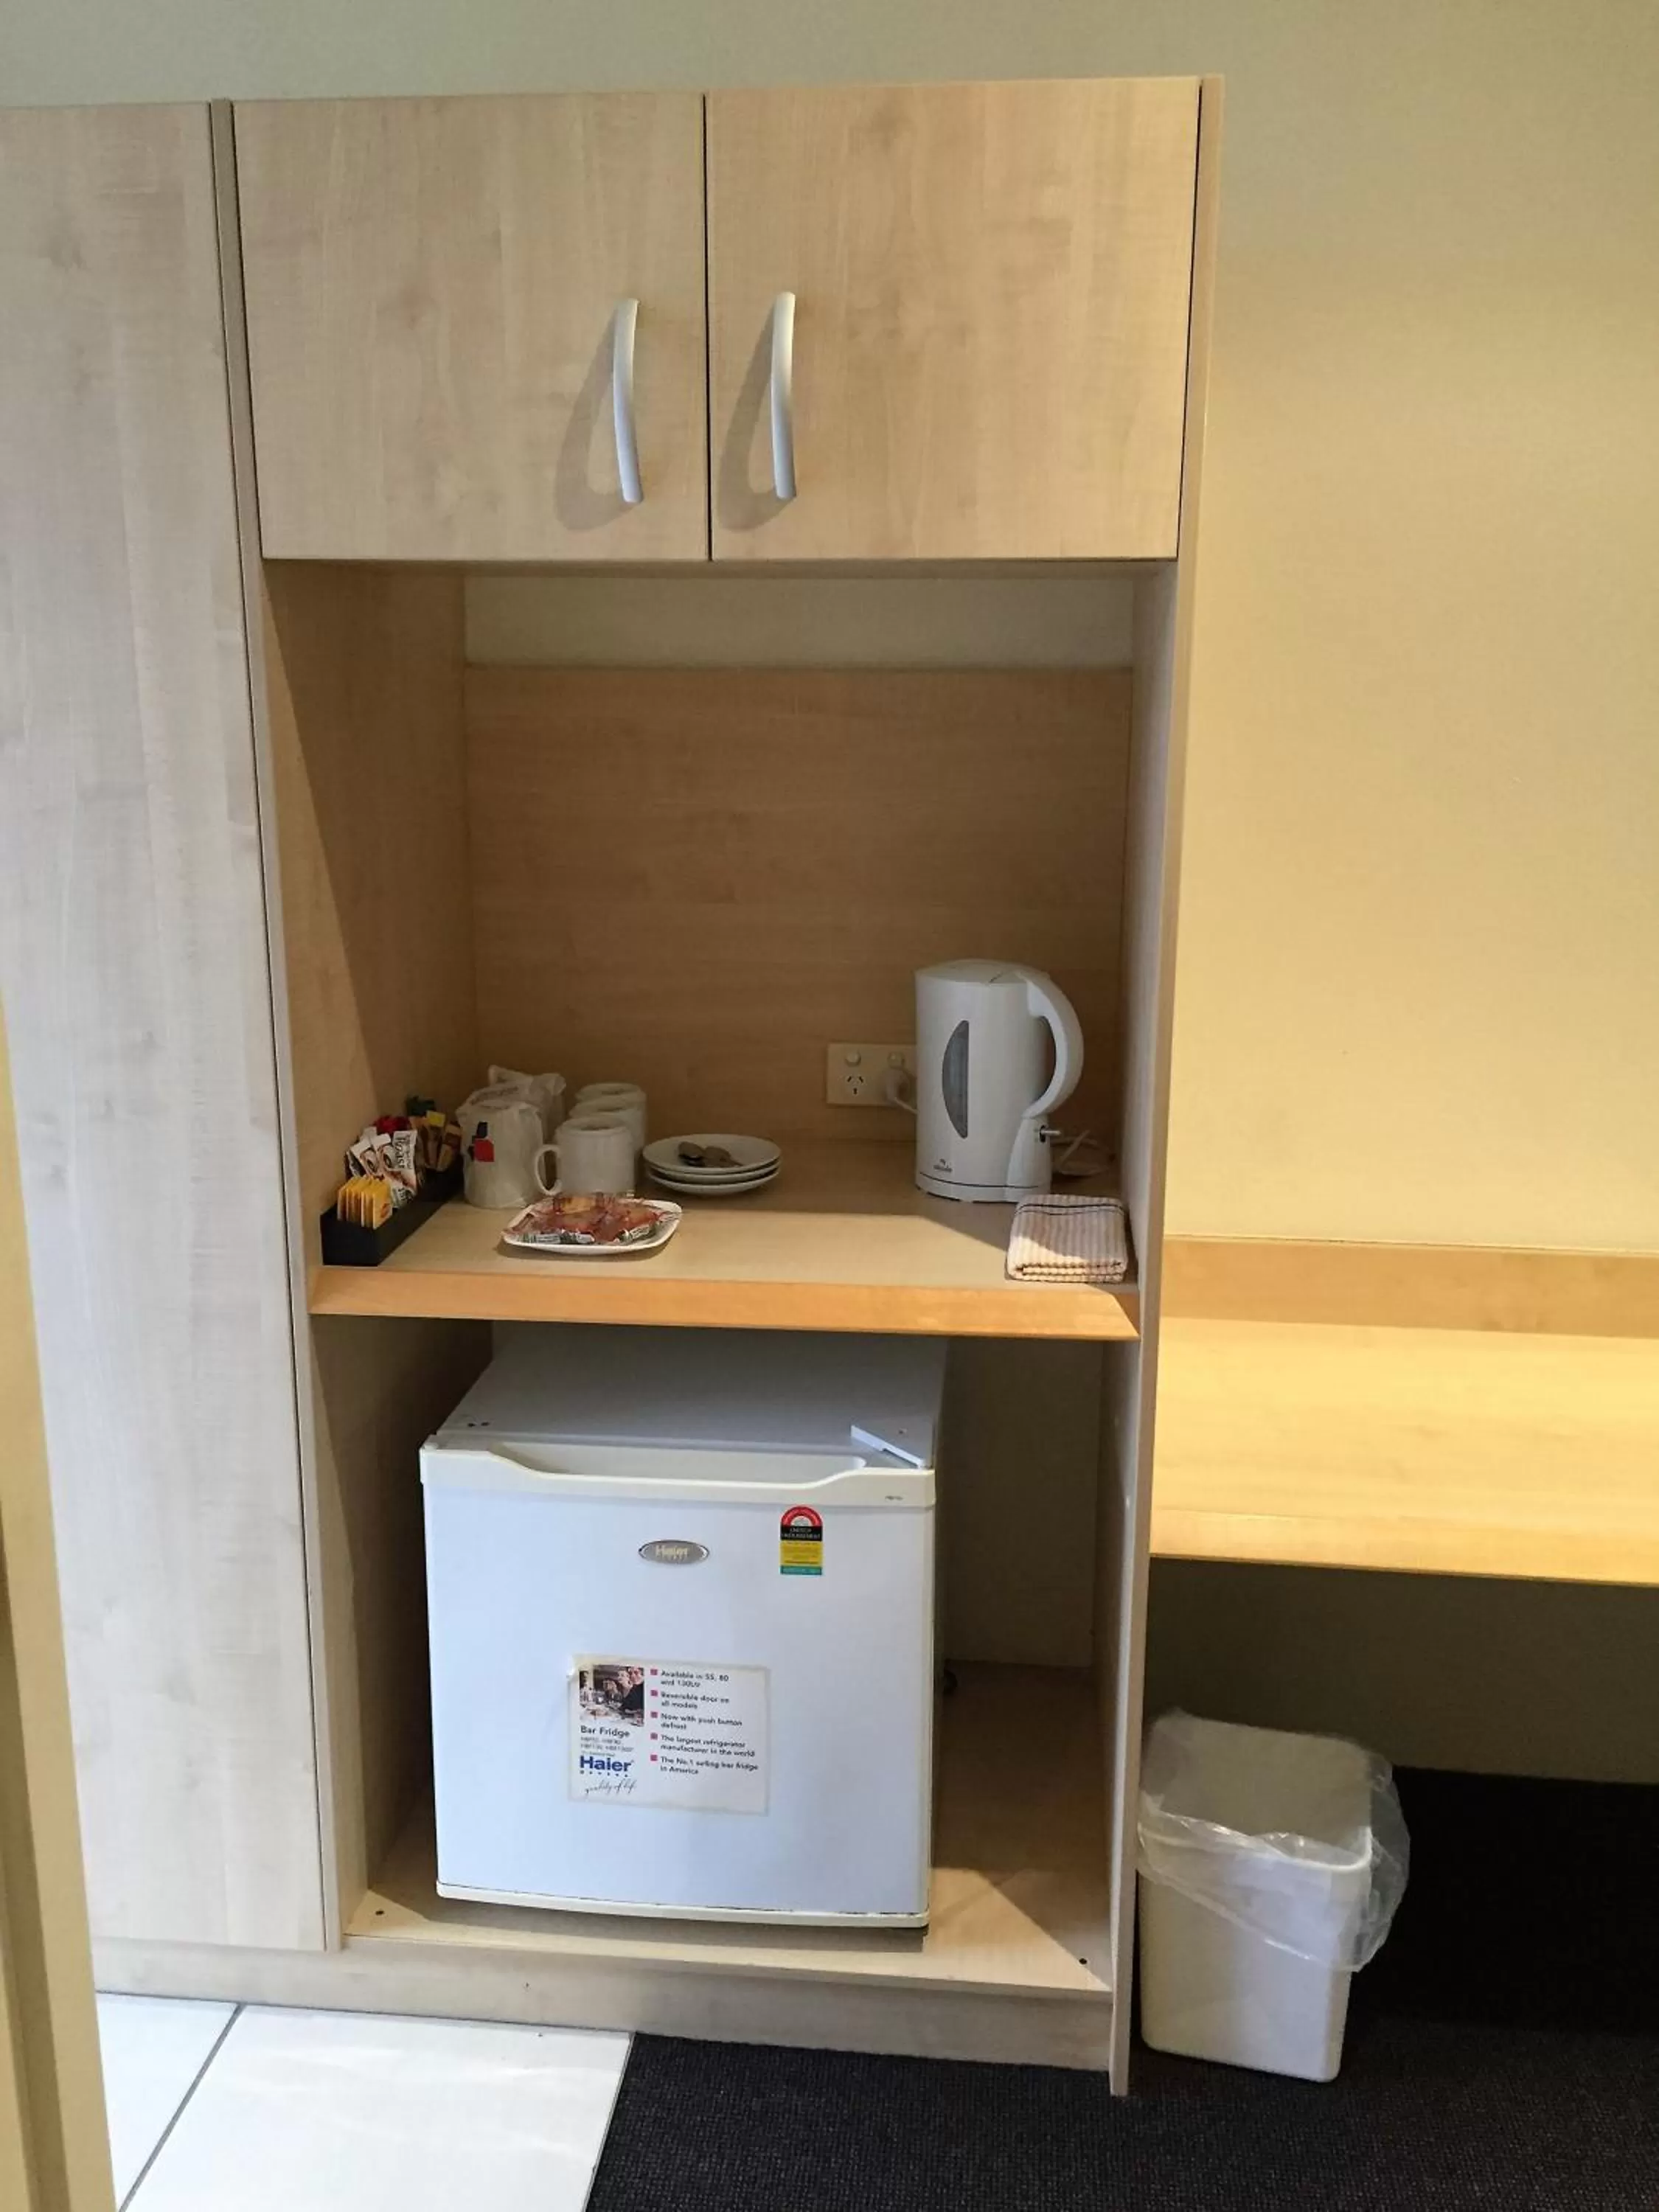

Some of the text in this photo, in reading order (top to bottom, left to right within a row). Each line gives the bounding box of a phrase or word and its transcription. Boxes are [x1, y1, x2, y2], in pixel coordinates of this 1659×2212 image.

[661, 1722, 686, 1730] defrost
[698, 1716, 715, 1725] push
[717, 1718, 742, 1726] button
[580, 1725, 630, 1739] Bar Fridge
[661, 1733, 745, 1747] The largest refrigerator
[661, 1745, 708, 1753] manufacturer
[580, 1755, 632, 1772] Haier
[661, 1756, 674, 1764] The
[695, 1759, 720, 1769] selling
[735, 1762, 759, 1771] fridge
[669, 1766, 698, 1775] America
